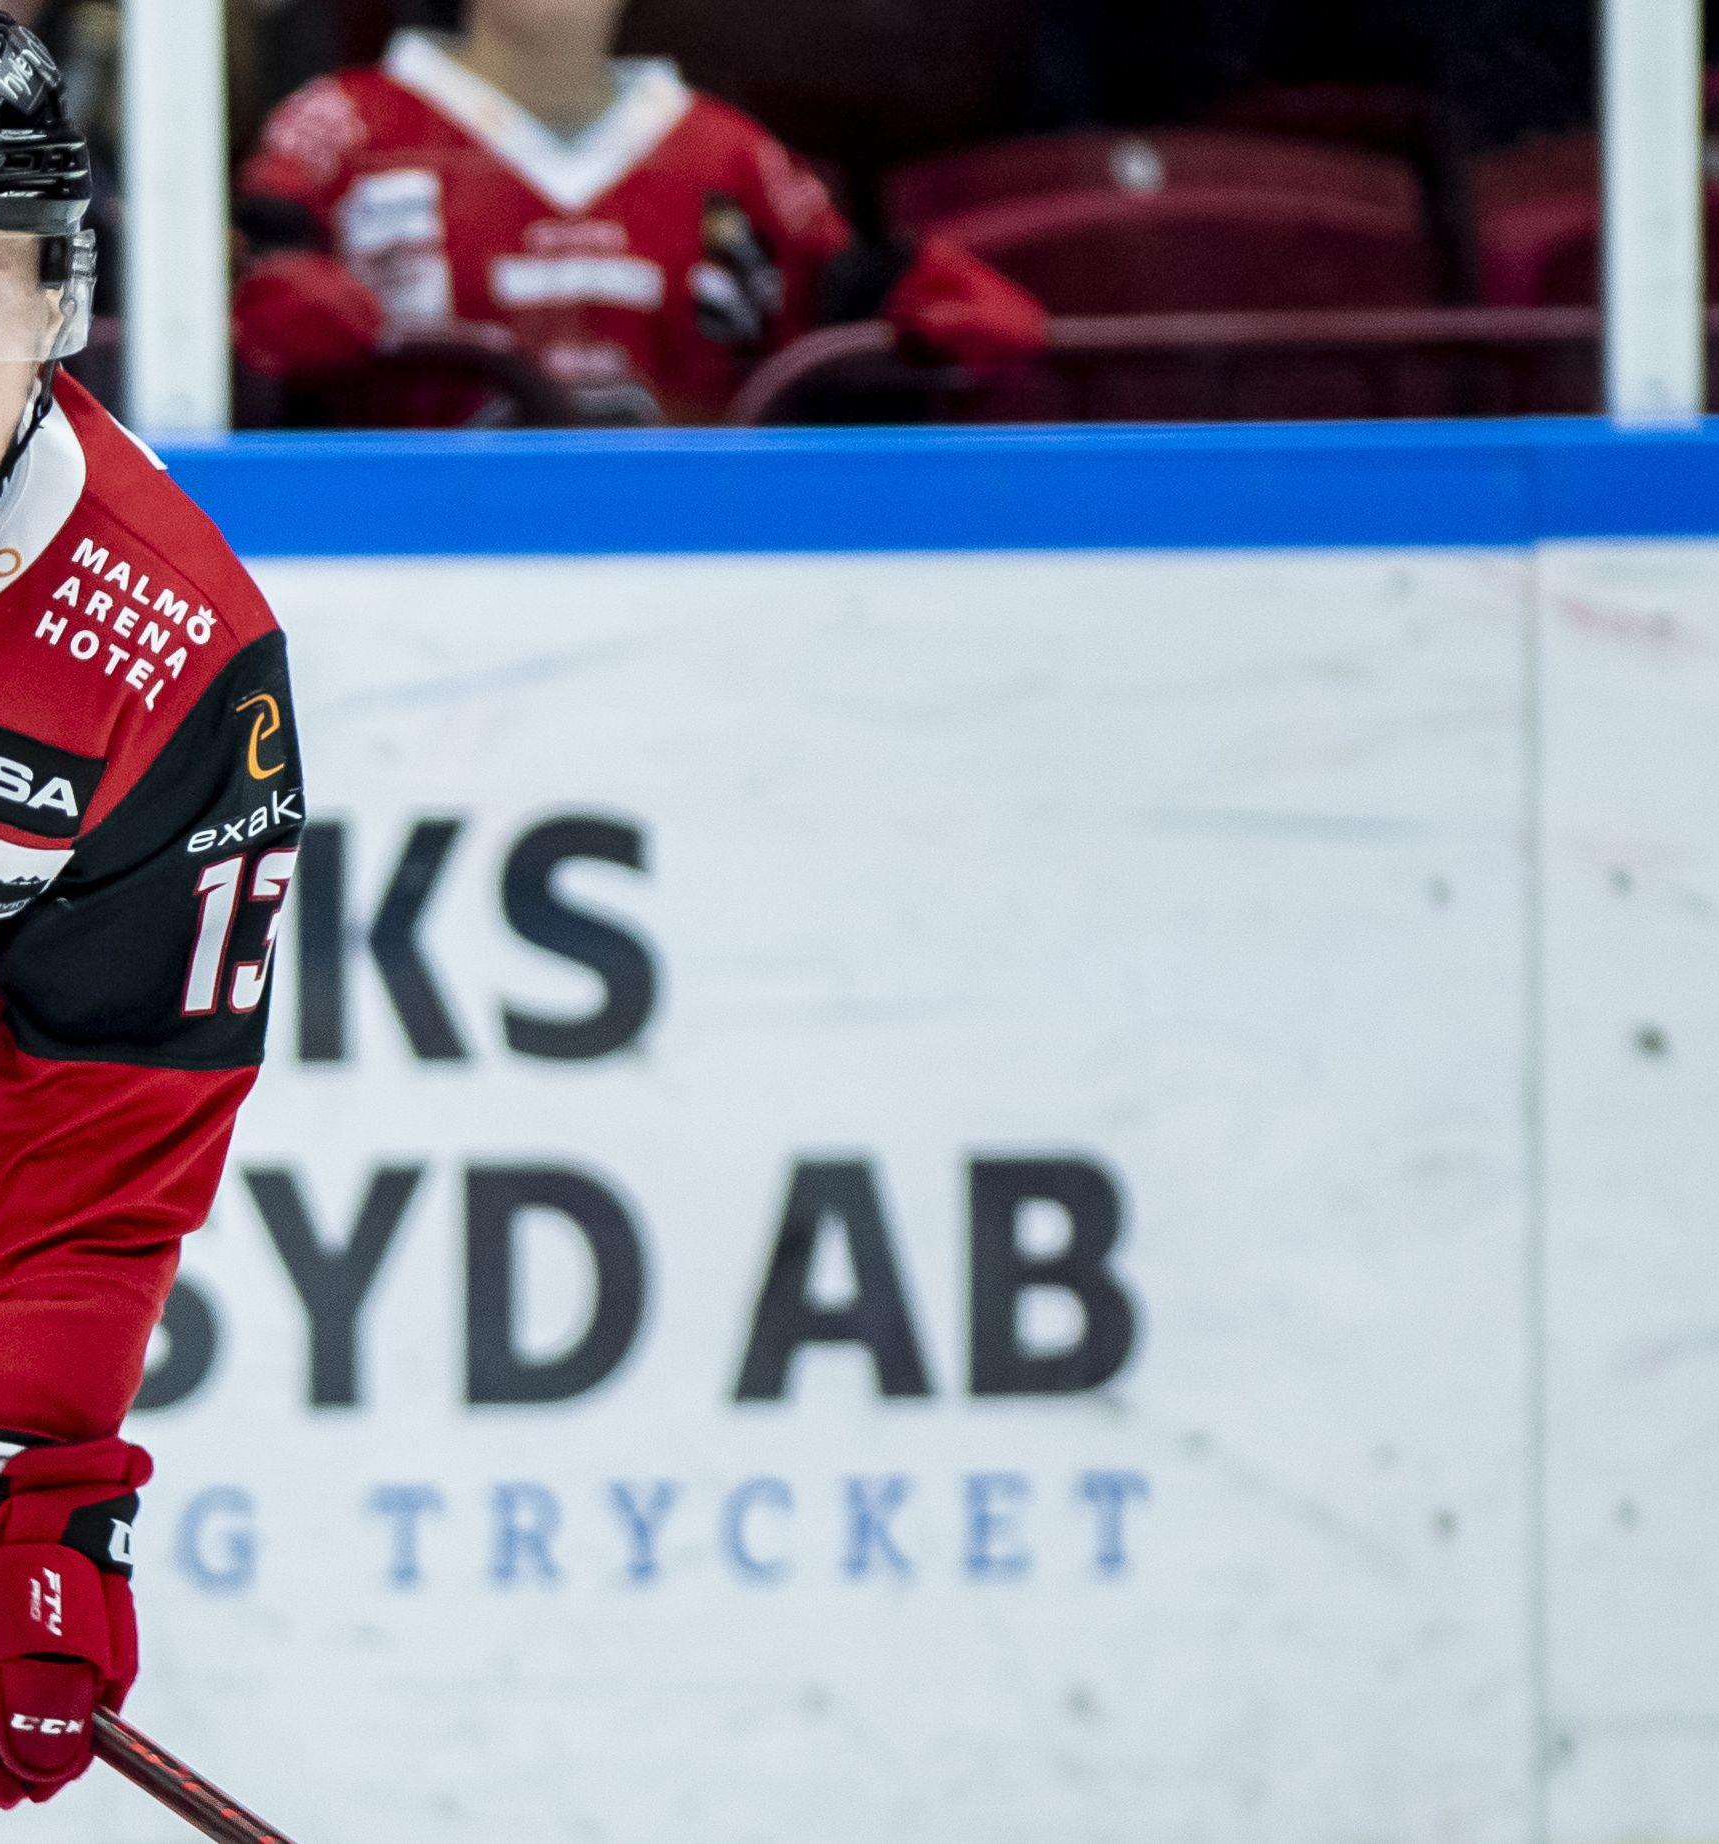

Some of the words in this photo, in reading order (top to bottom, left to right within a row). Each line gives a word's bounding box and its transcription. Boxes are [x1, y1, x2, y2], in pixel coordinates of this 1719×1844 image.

[34, 609, 164, 712] HOTEL
[52, 576, 190, 681] ARENA
[731, 1150, 1141, 1405] AB
[369, 1468, 1153, 1590] TRYCKET
[10, 1712, 85, 1735] CCM
